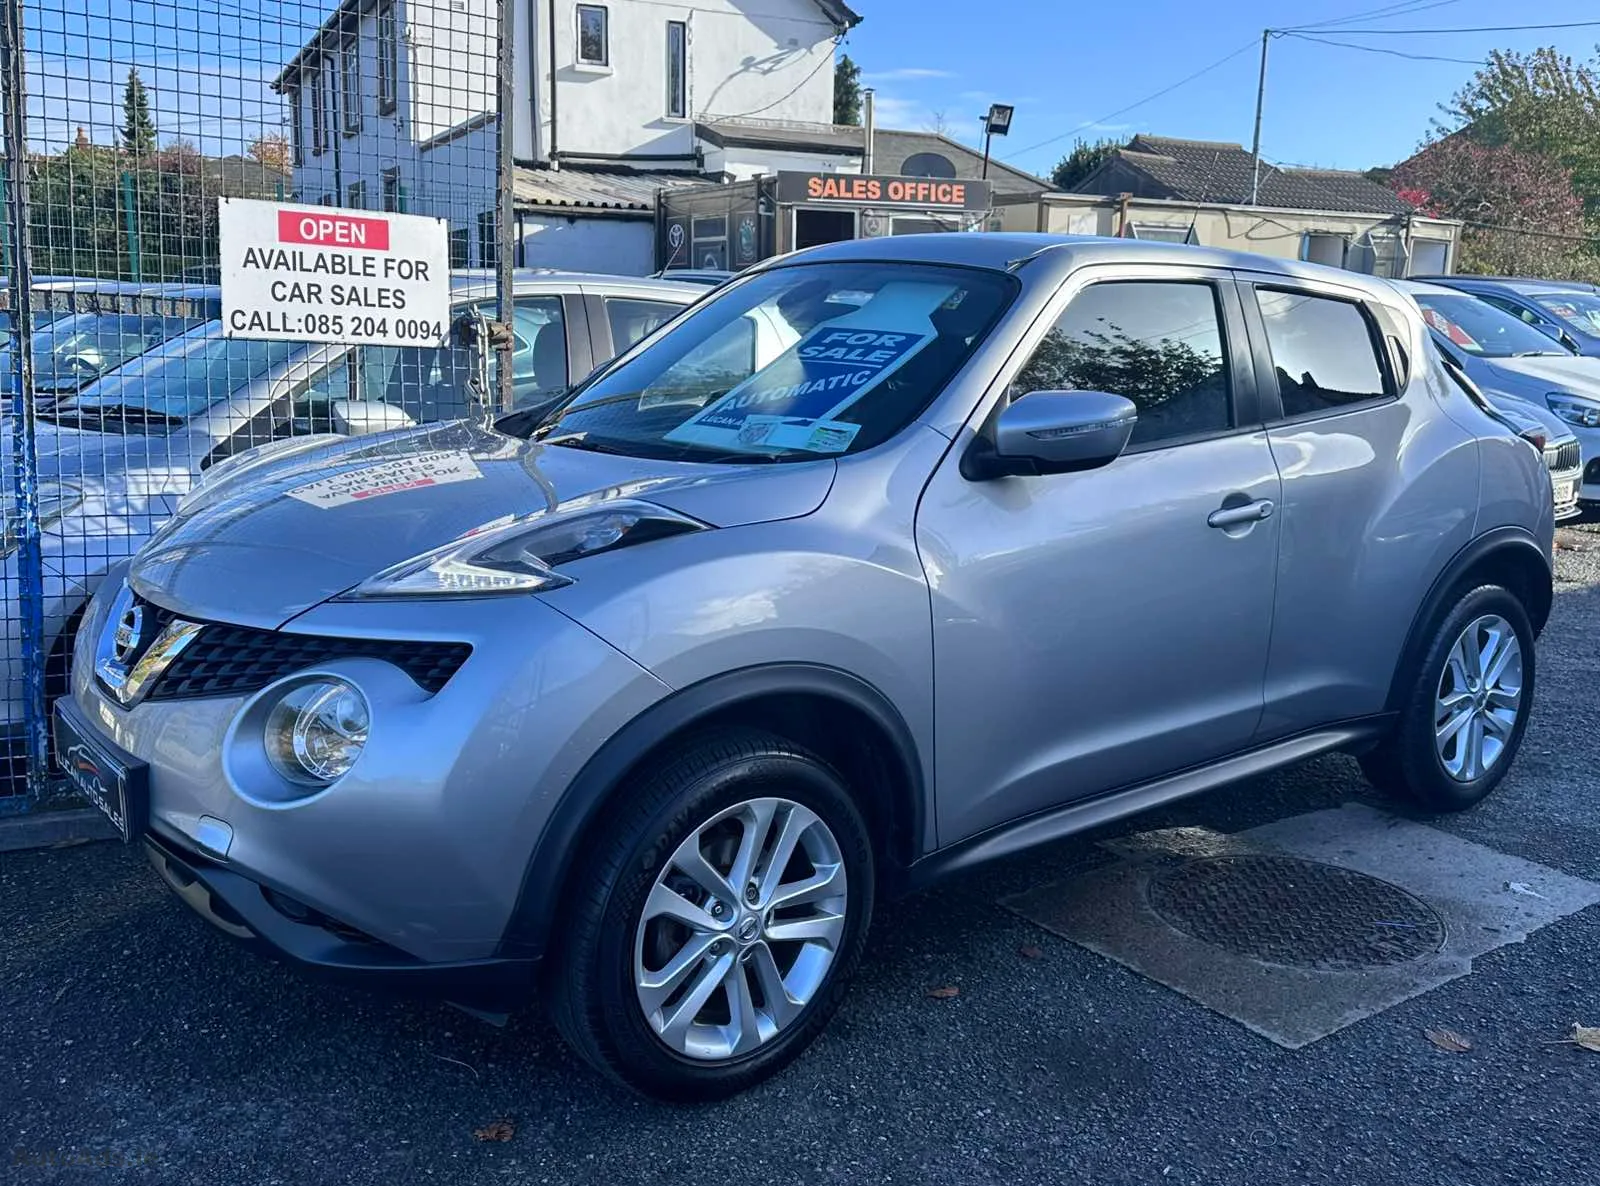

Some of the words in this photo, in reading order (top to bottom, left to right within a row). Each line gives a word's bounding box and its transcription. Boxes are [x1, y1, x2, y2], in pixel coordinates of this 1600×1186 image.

[807, 175, 881, 200] SALES
[888, 180, 965, 204] OFFICE
[299, 217, 366, 245] OPEN
[242, 247, 376, 278] AVAILABLE
[384, 258, 430, 282] FOR
[271, 280, 322, 305] CAR
[330, 284, 406, 310] SALES
[230, 309, 344, 336] CALL:085
[351, 316, 389, 339] 204
[395, 319, 443, 341] 0094
[821, 332, 906, 348] FOR
[798, 346, 898, 364] SALE
[716, 369, 873, 414] AUTOMATIC
